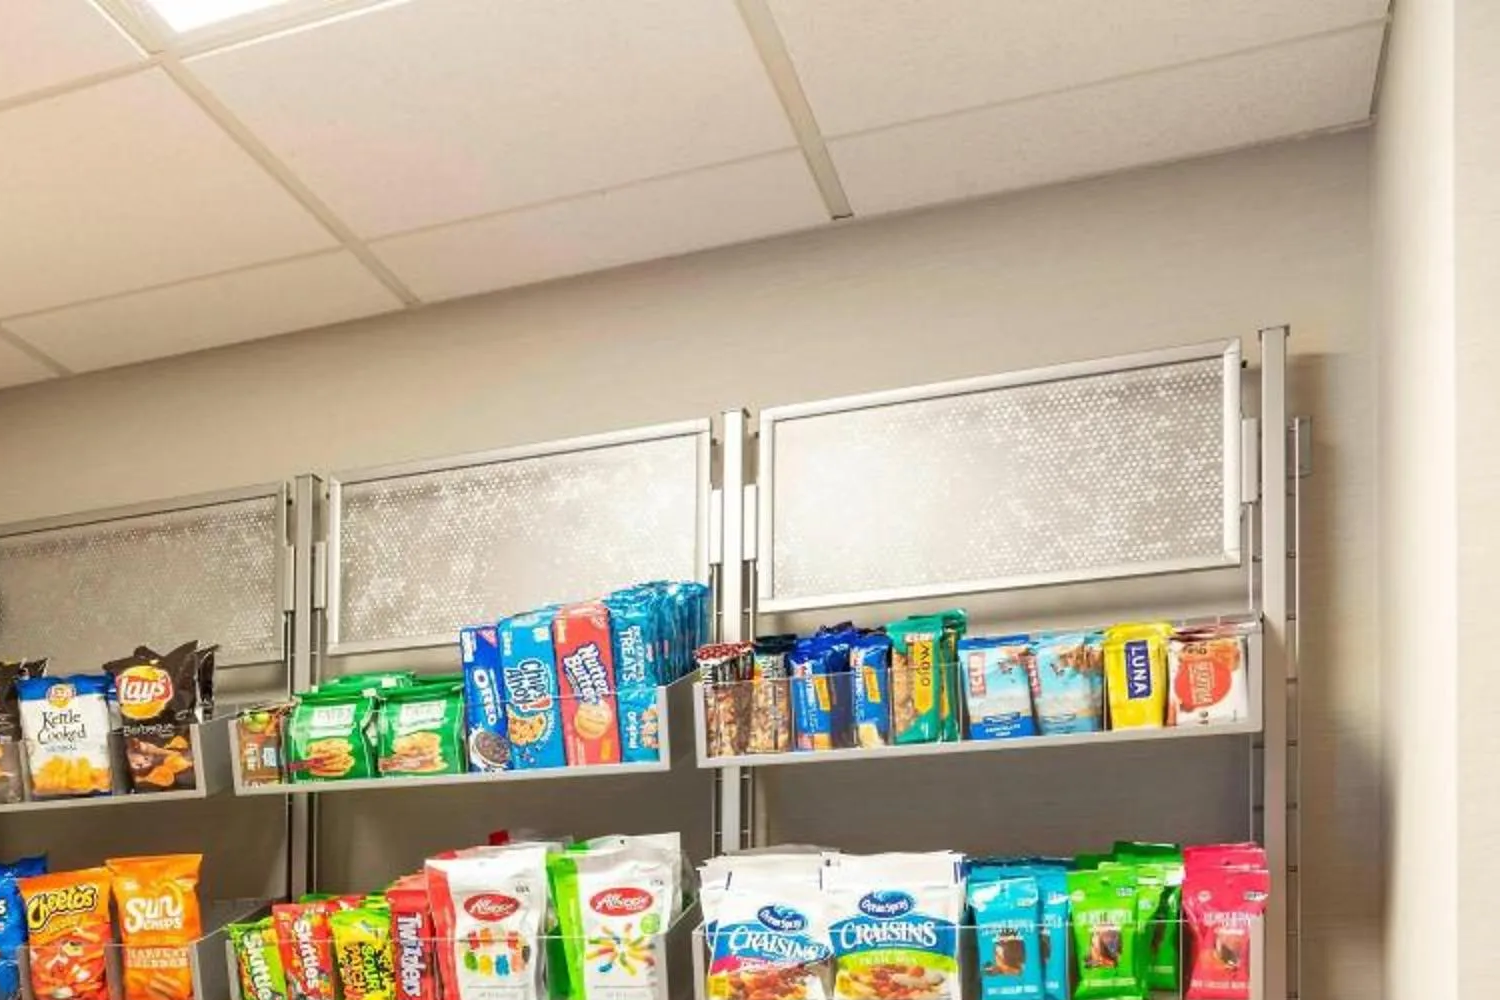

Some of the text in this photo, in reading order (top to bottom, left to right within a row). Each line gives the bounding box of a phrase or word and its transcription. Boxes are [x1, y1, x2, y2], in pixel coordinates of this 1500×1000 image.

[619, 630, 637, 682] TREATS
[920, 644, 934, 687] MOJO
[1129, 645, 1149, 695] LUNA
[117, 673, 173, 702] Lay's
[37, 724, 88, 747] Cooked
[41, 708, 82, 730] Kettle
[26, 884, 100, 932] Cheetos
[125, 894, 185, 934] Sun
[840, 921, 937, 950] CRAISINS
[344, 944, 365, 995] PATCH
[362, 945, 381, 992] SOUR
